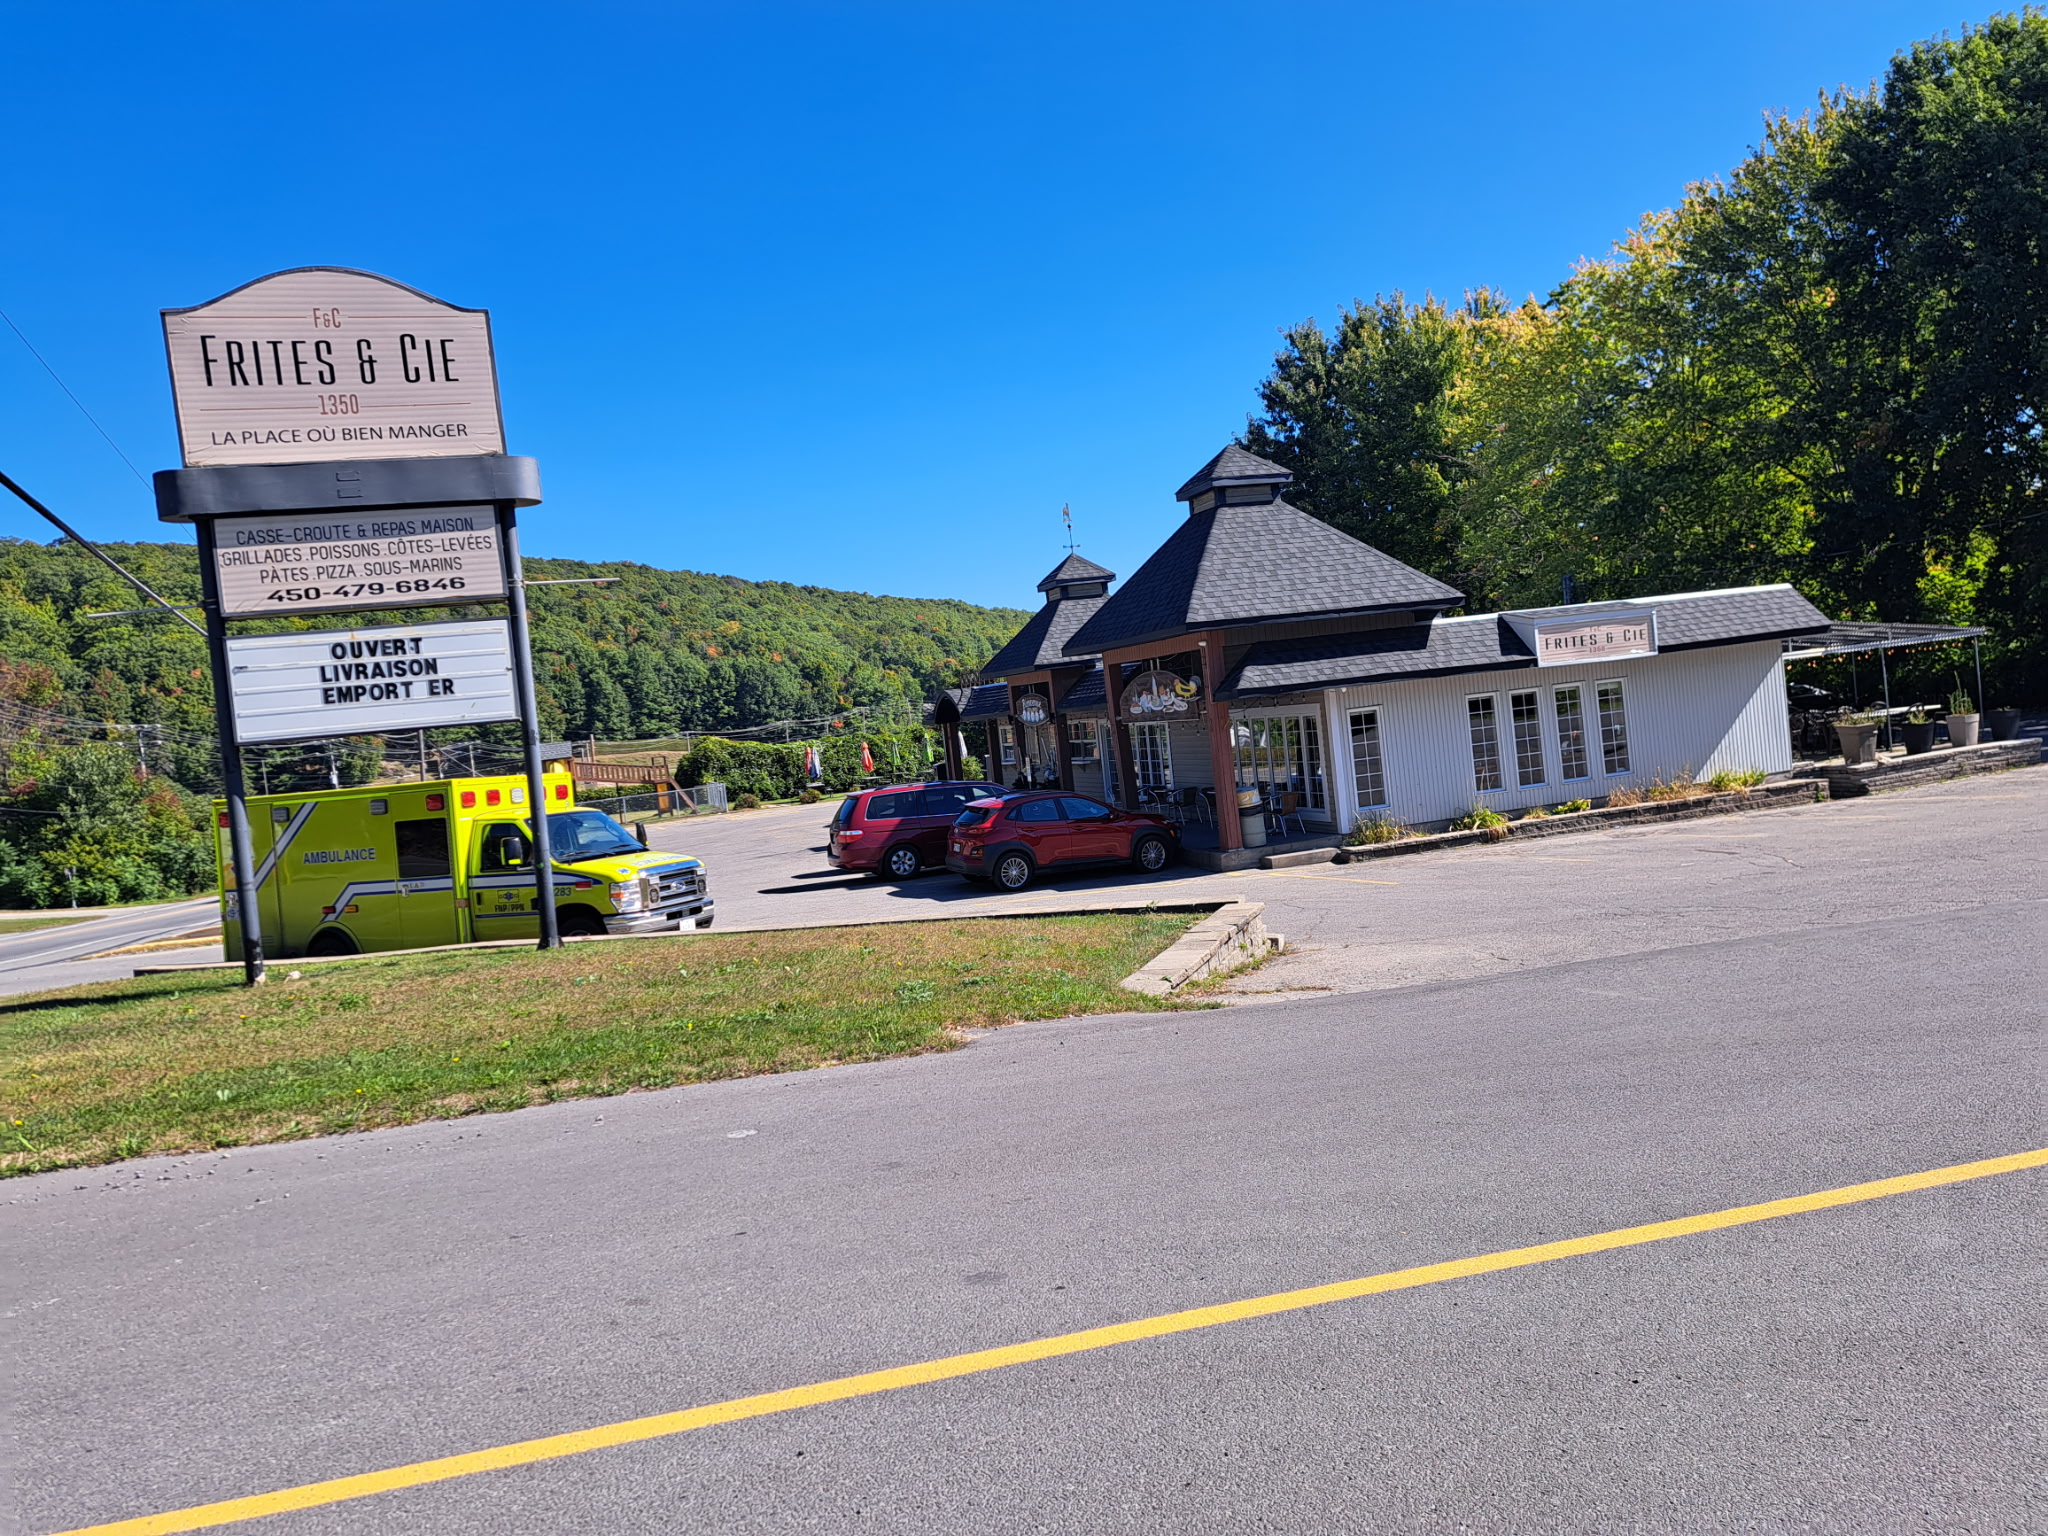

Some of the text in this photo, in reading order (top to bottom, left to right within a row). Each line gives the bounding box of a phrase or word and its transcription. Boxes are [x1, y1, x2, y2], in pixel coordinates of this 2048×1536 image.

[313, 308, 342, 328] F&C
[200, 333, 460, 387] FRITES & CIE
[318, 394, 360, 415] 1350
[212, 423, 468, 445] LA PLACE OÙ BIEN MANGER
[236, 517, 473, 546] CASSE-CROUTE & REPAS MAISON
[222, 547, 302, 567] GRILLADES
[267, 577, 466, 602] 450-479-6846
[331, 638, 423, 659] OUVERT
[1545, 629, 1647, 650] FRITES & CIE
[320, 658, 438, 682] LIVRAISON
[303, 847, 376, 865] AMBULANCE
